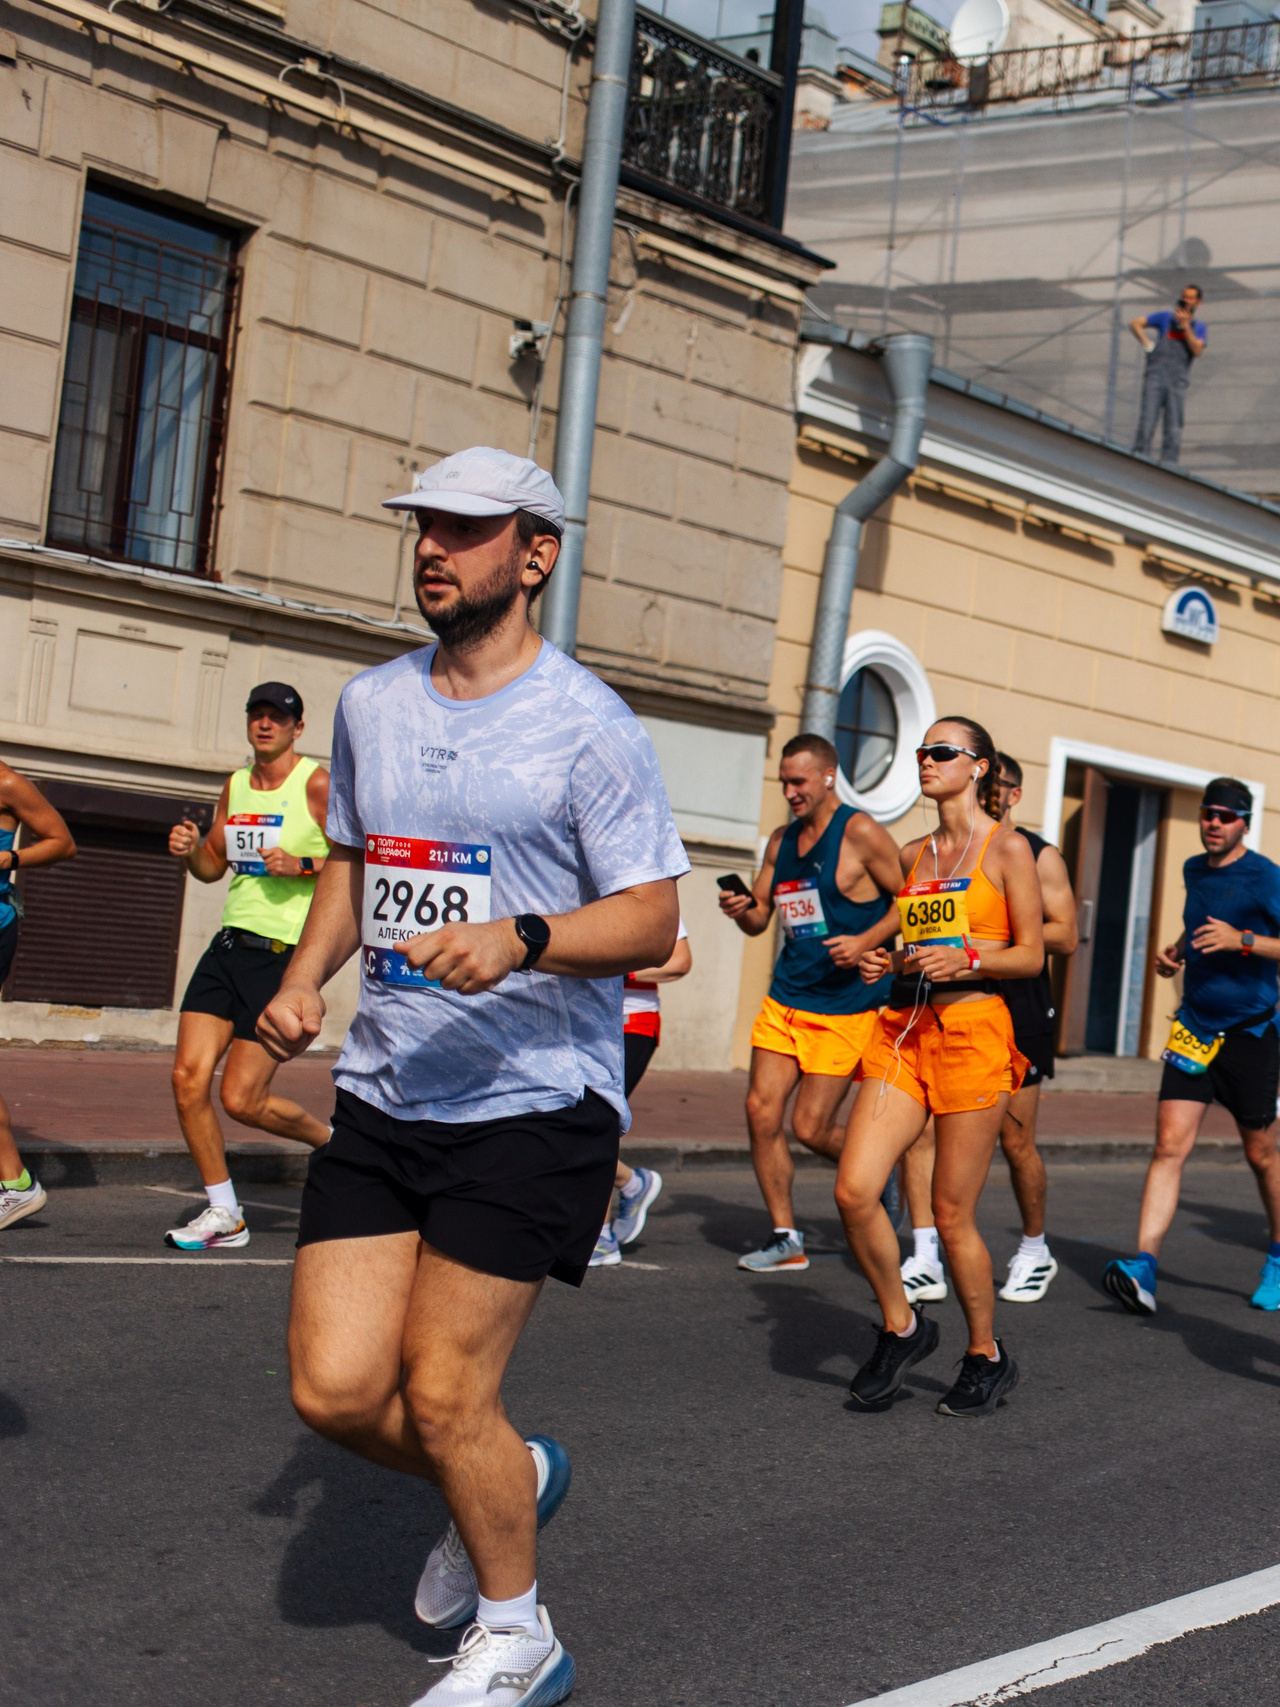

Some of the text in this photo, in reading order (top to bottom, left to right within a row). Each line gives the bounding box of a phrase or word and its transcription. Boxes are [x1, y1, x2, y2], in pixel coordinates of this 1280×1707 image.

[236, 831, 264, 850] 511
[377, 838, 395, 846] ПОЛУ
[377, 847, 411, 858] МАРАФОН
[429, 849, 449, 864] 21,1
[451, 851, 472, 865] КМ
[373, 877, 469, 927] 2968
[780, 898, 815, 921] 7536
[907, 898, 955, 927] 6380
